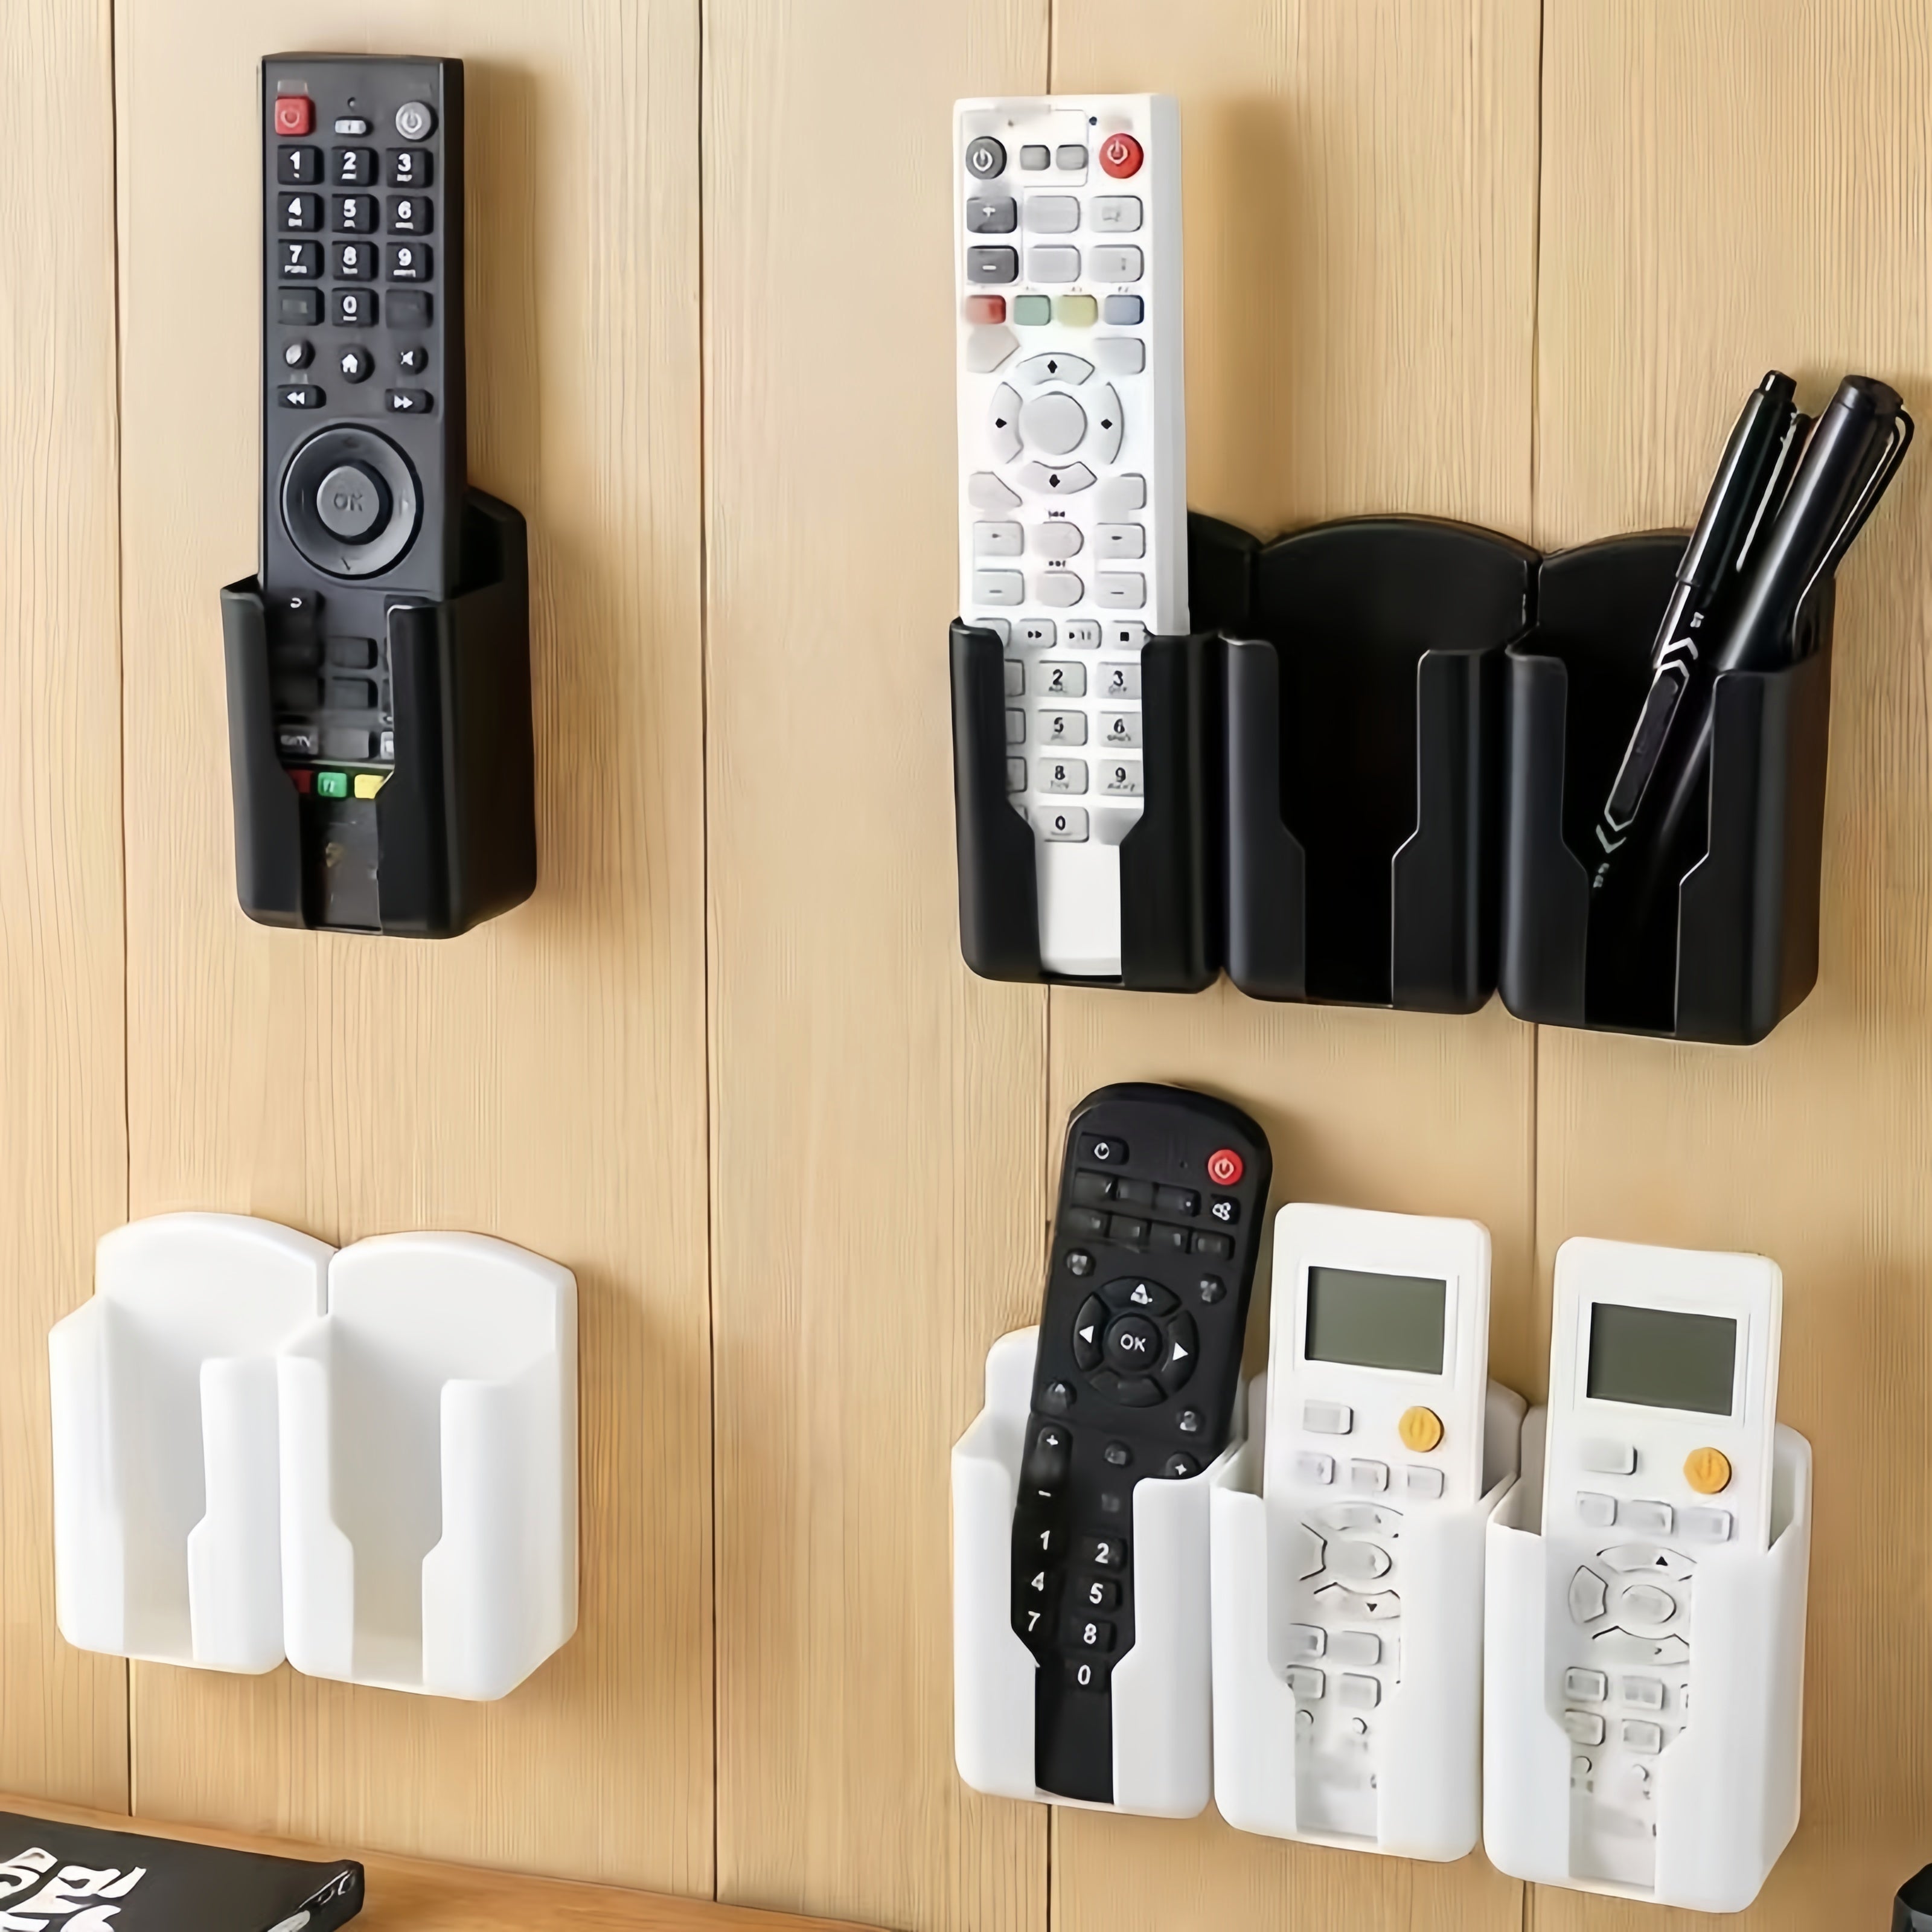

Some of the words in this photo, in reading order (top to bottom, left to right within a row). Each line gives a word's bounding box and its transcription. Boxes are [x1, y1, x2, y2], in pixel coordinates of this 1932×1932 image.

[290, 151, 300, 170] 1
[343, 152, 356, 170] 2
[398, 153, 411, 171] 3
[288, 197, 302, 216] 4
[344, 199, 356, 217] 5
[398, 200, 412, 219] 6
[289, 245, 302, 263] 7
[343, 246, 357, 265] 8
[398, 248, 412, 266] 9
[343, 296, 357, 314] 0
[333, 493, 363, 513] OK
[1052, 669, 1063, 686] 2
[1113, 670, 1124, 687] 3
[1054, 717, 1064, 734] 5
[1113, 718, 1125, 734] 6
[1054, 765, 1066, 781] 8
[1115, 767, 1127, 783] 9
[1055, 815, 1066, 831] 0
[1120, 1334, 1146, 1352] OK
[1040, 1530, 1051, 1550] 1
[1095, 1543, 1109, 1564] 2
[1031, 1572, 1044, 1591] 4
[1089, 1582, 1104, 1604] 5
[1028, 1611, 1041, 1632] 7
[1083, 1623, 1097, 1645] 8
[1077, 1665, 1091, 1685] 0
